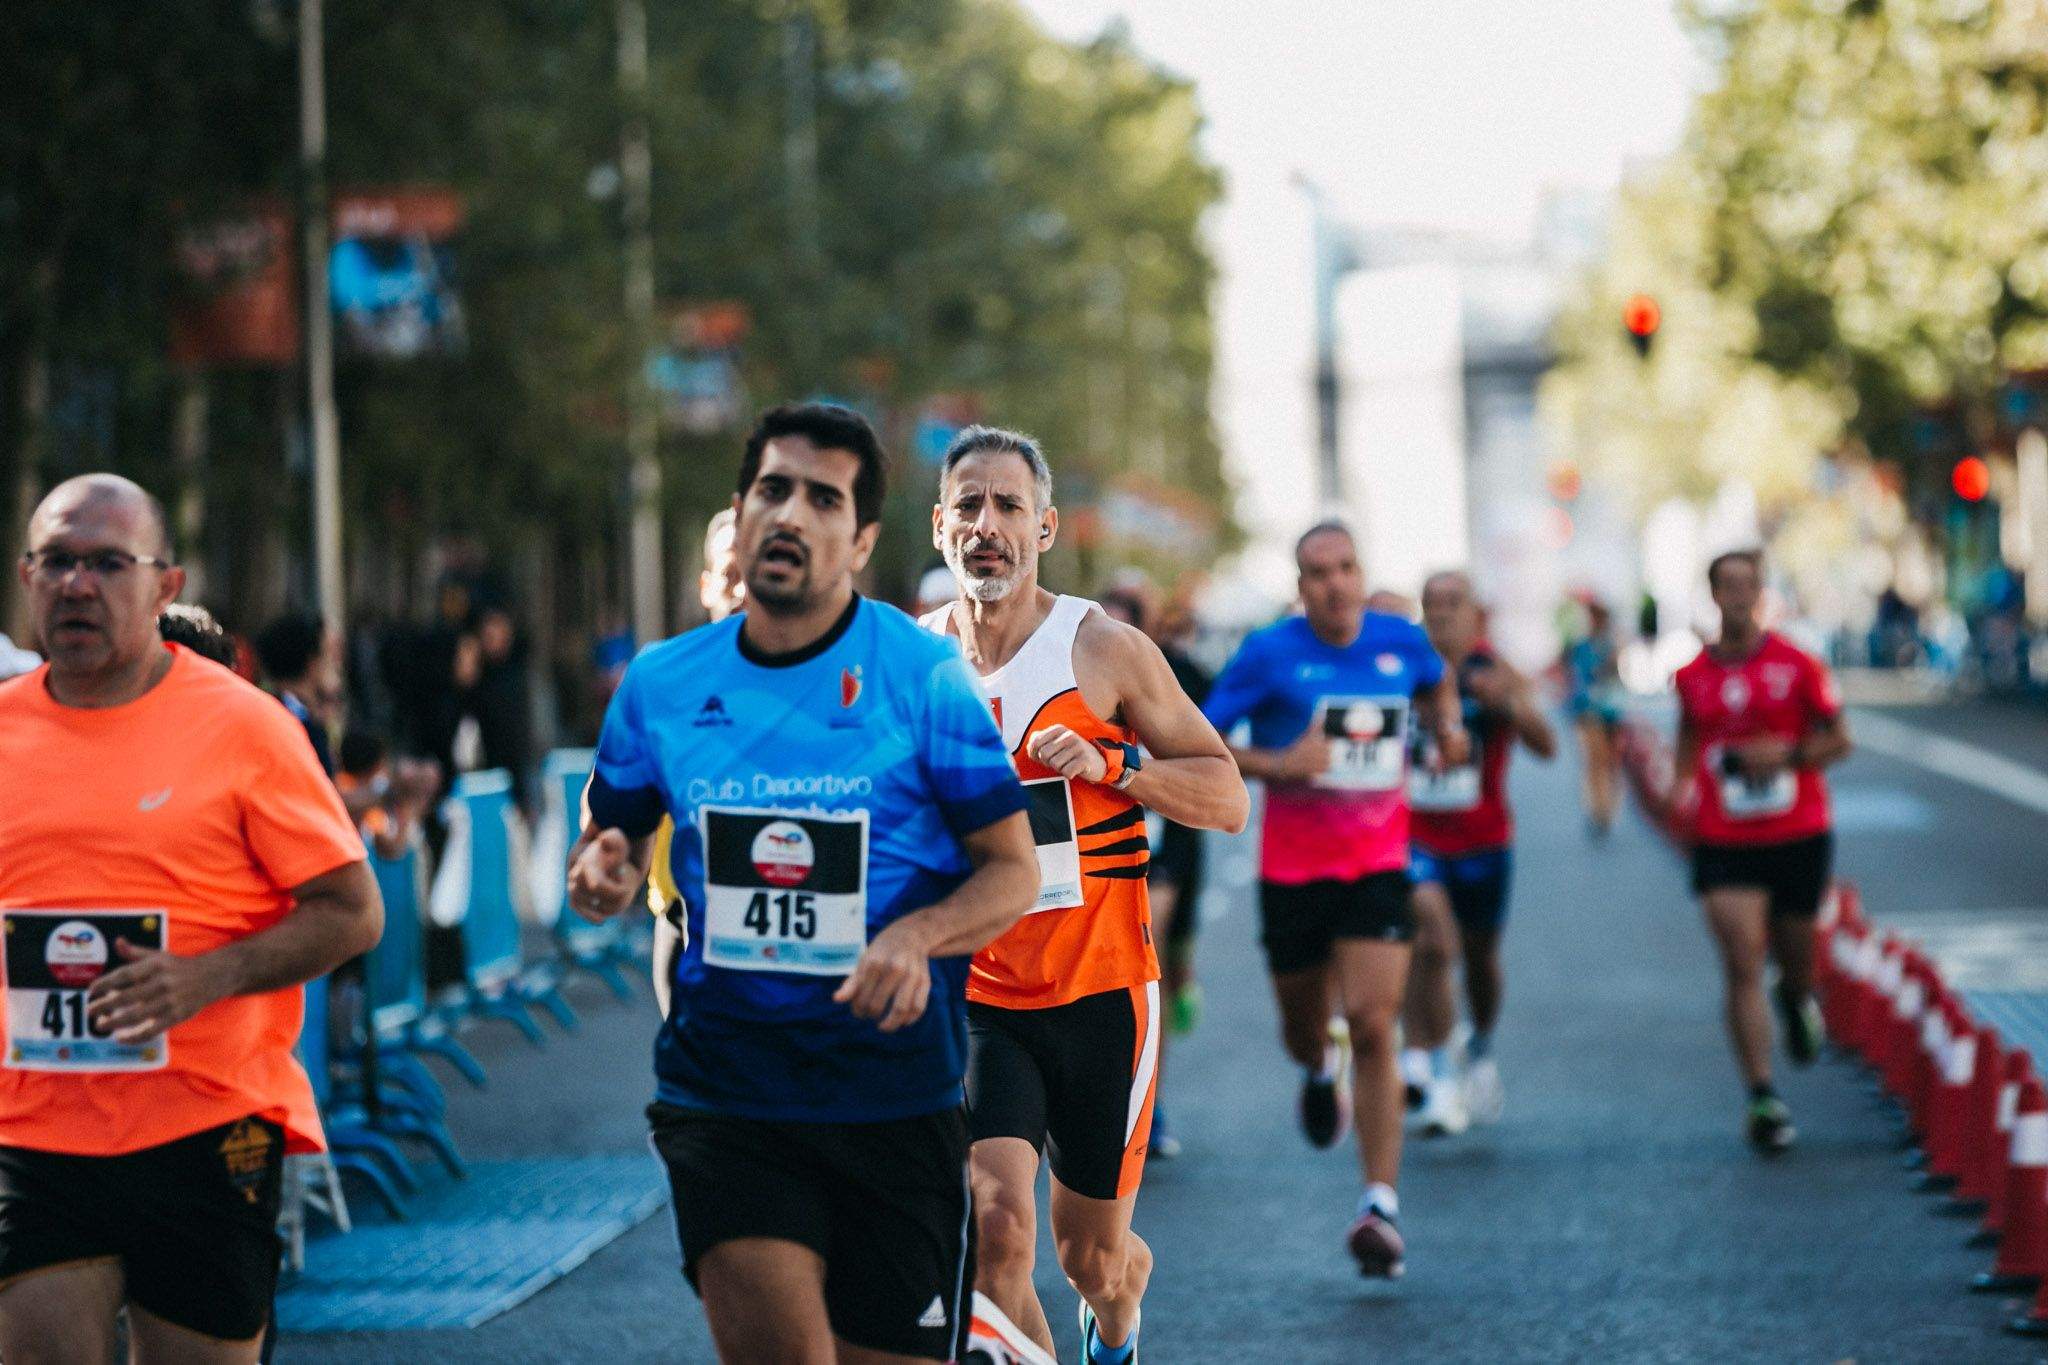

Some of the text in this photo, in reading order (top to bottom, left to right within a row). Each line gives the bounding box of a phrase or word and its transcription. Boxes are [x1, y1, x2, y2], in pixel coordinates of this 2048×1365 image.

[688, 773, 872, 804] Club Deportivo
[744, 892, 817, 940] 415
